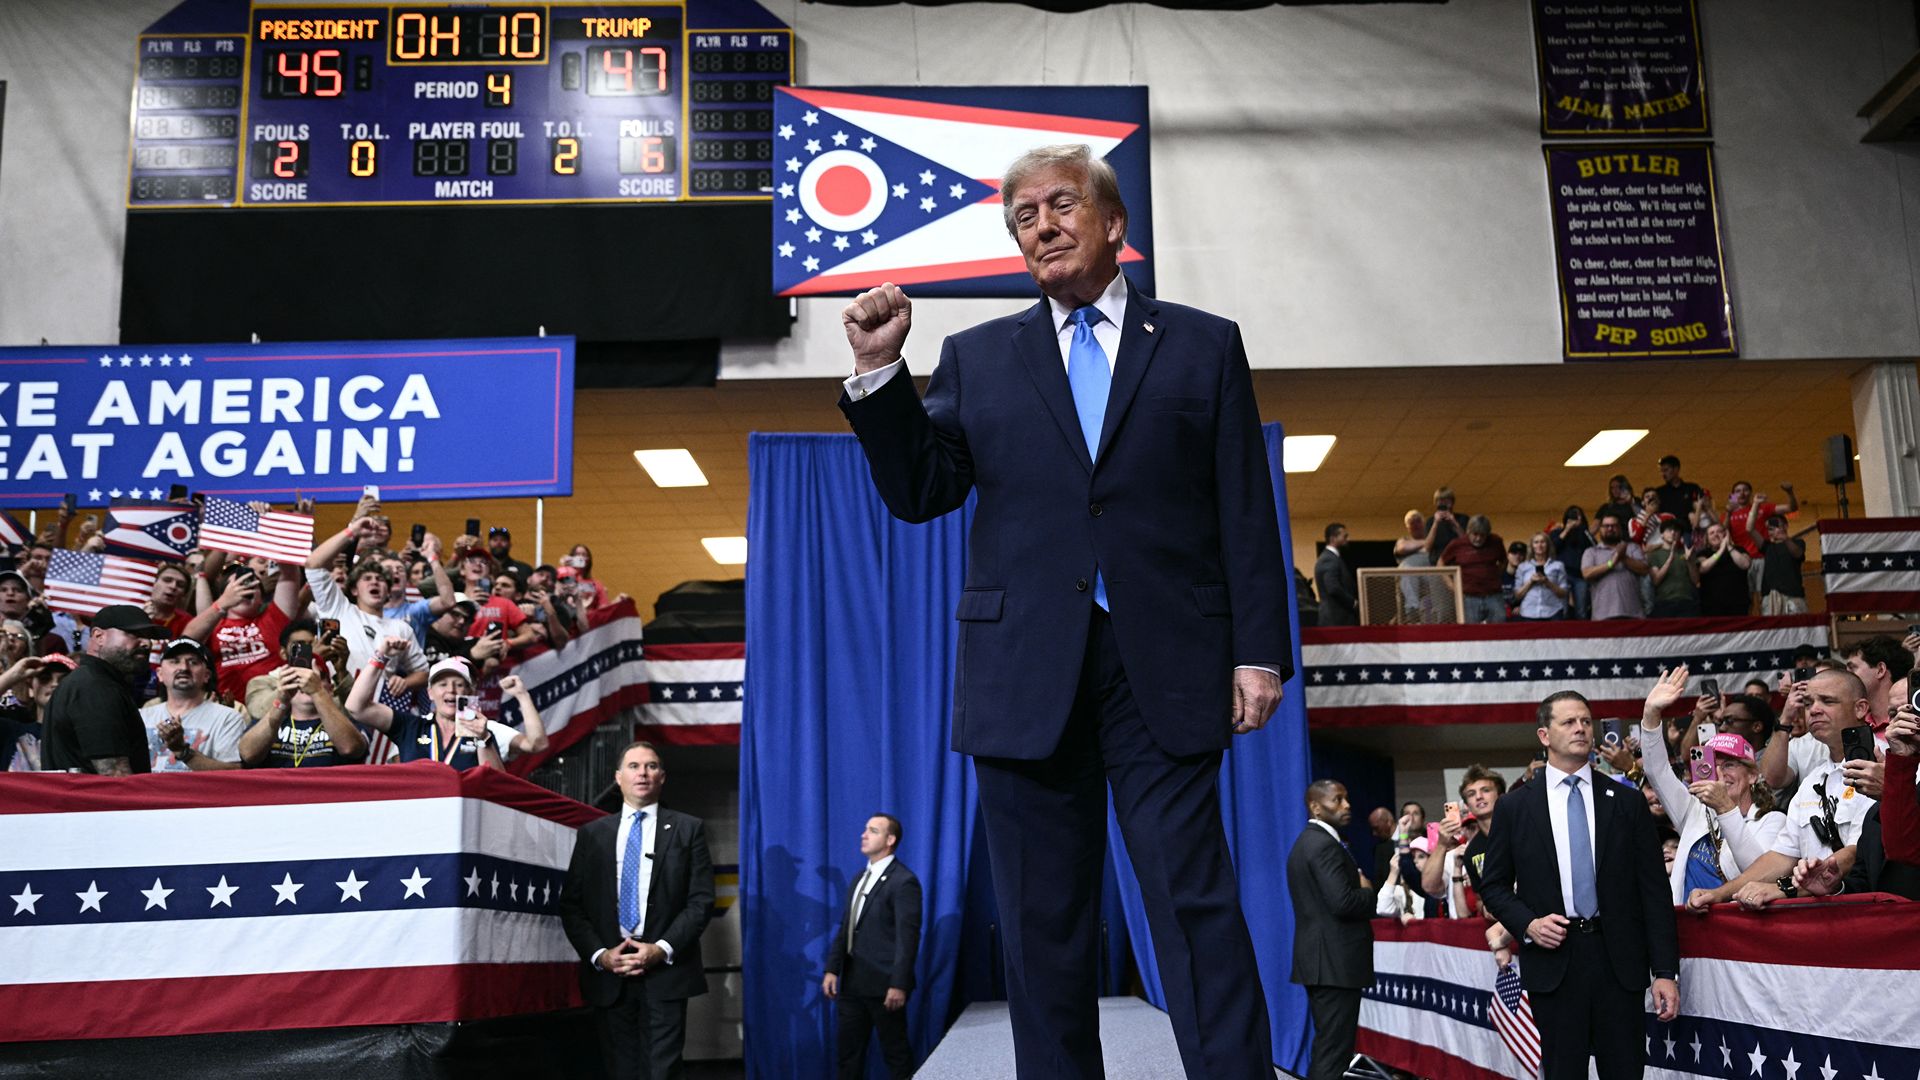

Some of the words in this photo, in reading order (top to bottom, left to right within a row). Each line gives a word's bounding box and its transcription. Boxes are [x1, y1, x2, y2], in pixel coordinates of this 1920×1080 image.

[260, 19, 379, 40] PRESIDENT
[499, 12, 541, 58] 10
[581, 17, 651, 38] TRUMP
[148, 40, 173, 53] PLYR
[184, 40, 201, 53] FLS
[215, 39, 234, 52] PTS
[696, 36, 721, 48] PLYR
[731, 35, 748, 48] FLS
[760, 35, 779, 48] PTS
[278, 50, 342, 96] 45
[603, 47, 666, 91] 47
[1611, 65, 1626, 74] and
[414, 81, 479, 99] PERIOD
[487, 74, 511, 105] 4
[1556, 95, 1614, 119] ALMA
[1623, 91, 1691, 120] MATER
[254, 124, 310, 141] FOULS
[340, 123, 391, 140] T.O.L.
[408, 123, 475, 140] PLAYER
[481, 121, 524, 138] FOUL
[543, 121, 593, 138] T.O.L.
[619, 120, 674, 137] FOULS
[273, 141, 299, 177] 2
[554, 138, 578, 174] 2
[641, 138, 664, 173] 6
[1577, 154, 1680, 178] BUTLER
[251, 184, 308, 200] SCORE
[435, 181, 493, 198] MATCH
[619, 178, 674, 195] SCORE
[1561, 184, 1574, 196] Oh
[1575, 184, 1598, 197] cheer,
[1600, 184, 1623, 197] cheer,
[1625, 184, 1645, 195] cheer
[1647, 184, 1659, 195] for
[1661, 184, 1683, 195] Butler
[1567, 201, 1579, 212] the
[1582, 201, 1601, 214] pride
[1603, 201, 1611, 212] of
[1613, 200, 1635, 212] Ohio.
[1640, 200, 1660, 211] We'll
[1661, 200, 1677, 213] ring
[1679, 201, 1692, 211] out
[1694, 199, 1706, 210] the
[1569, 218, 1588, 231] glory
[1591, 218, 1604, 229] and
[1606, 217, 1625, 229] we'll
[1626, 217, 1639, 228] tell
[1641, 216, 1650, 228] all
[1651, 216, 1664, 228] the
[1666, 218, 1686, 230] story
[1687, 215, 1696, 227] of
[1570, 234, 1583, 246] the
[1585, 234, 1609, 245] school
[1611, 236, 1622, 245] we
[1623, 233, 1640, 245] love
[1642, 233, 1655, 244] the
[1656, 233, 1675, 244] best.
[1570, 257, 1582, 269] Oh
[1584, 257, 1608, 270] cheer,
[1609, 257, 1633, 269] cheer,
[1635, 256, 1655, 268] cheer
[1657, 256, 1668, 267] for
[1671, 255, 1693, 267] Butler
[1696, 255, 1716, 269] High,
[1574, 276, 1588, 286] our
[1590, 274, 1610, 286] Alma
[1612, 273, 1634, 285] Mater
[1636, 275, 1655, 286] true,
[1657, 273, 1671, 285] and
[1672, 272, 1691, 284] we'll
[1693, 272, 1717, 286] always
[1576, 291, 1597, 303] stand
[1598, 293, 1619, 304] every
[1620, 290, 1641, 302] heart
[1642, 289, 1651, 301] in
[1652, 289, 1674, 302] hand,
[1675, 288, 1688, 301] for
[1577, 307, 1590, 319] the
[1592, 306, 1614, 318] honor
[1617, 306, 1625, 318] of
[1627, 305, 1650, 318] Butler
[1652, 305, 1675, 319] High.
[1594, 323, 1638, 345] PEP
[1650, 322, 1708, 346] SONG
[0, 381, 59, 427] E
[88, 373, 441, 426] AMERICA
[142, 426, 417, 480] AGAIN!
